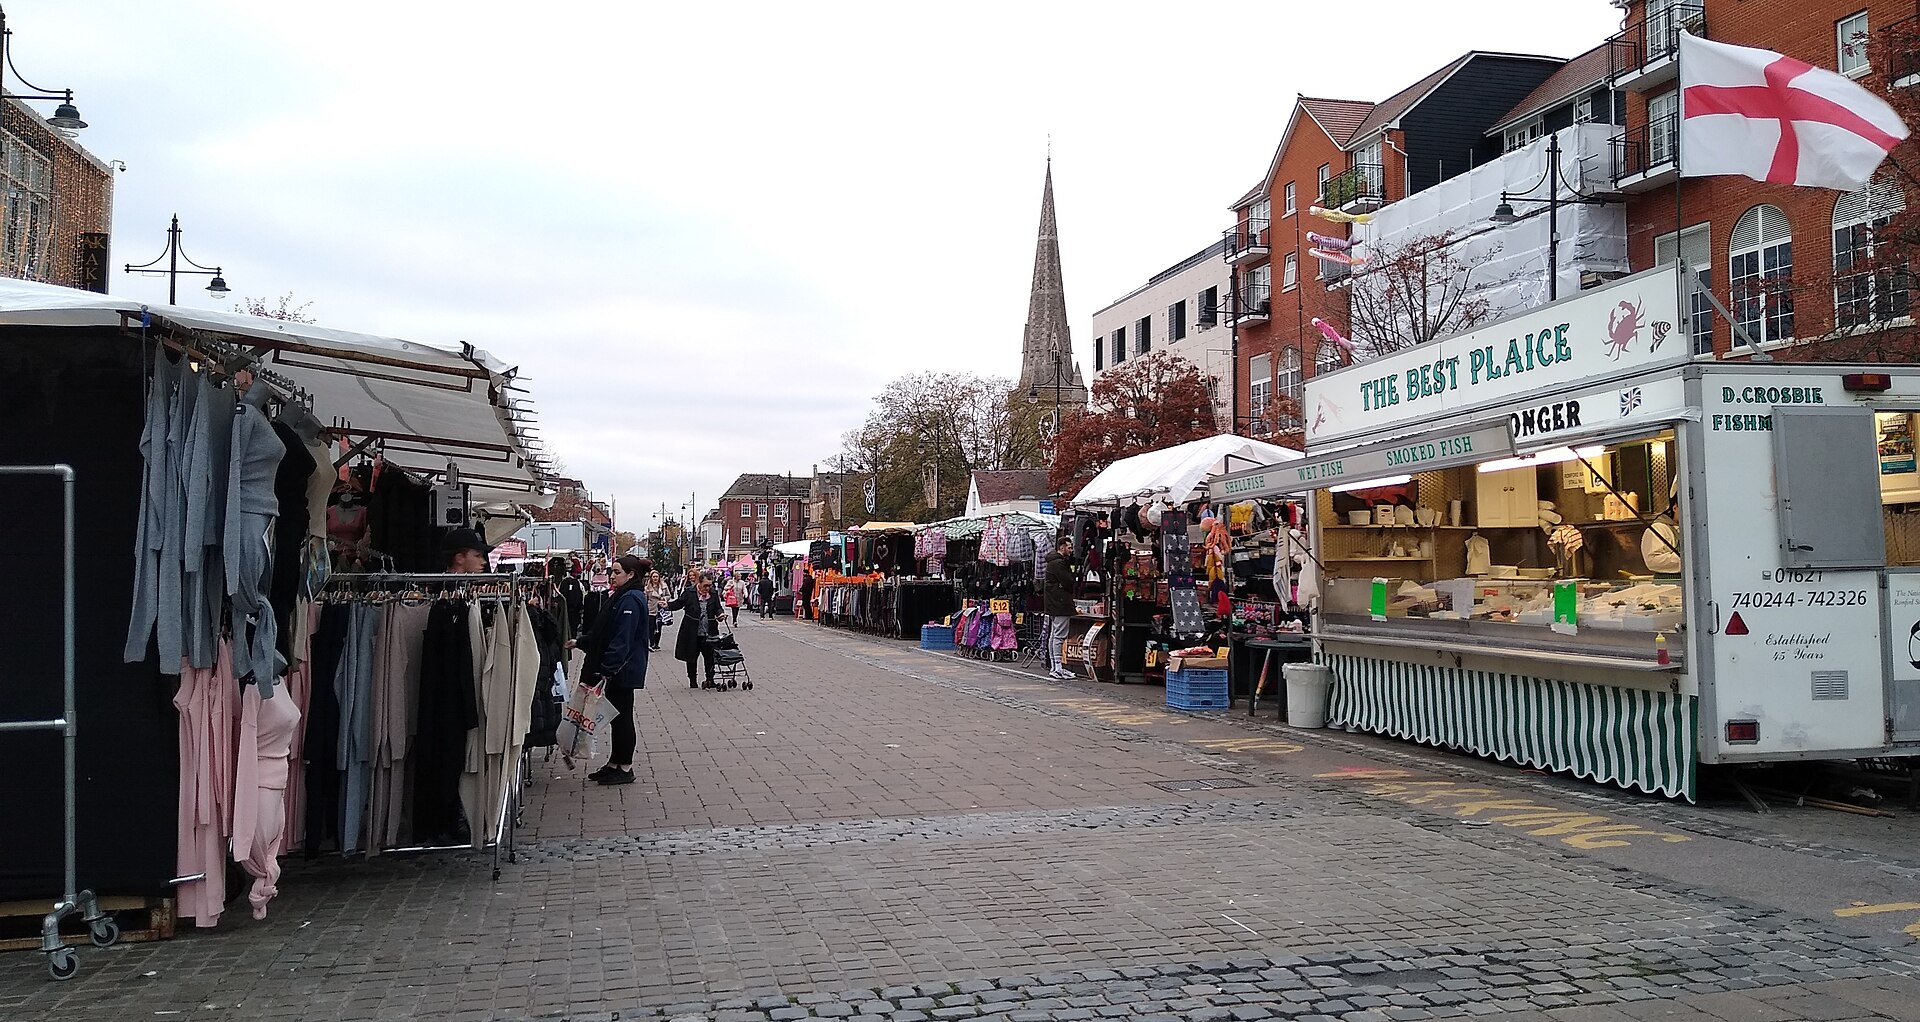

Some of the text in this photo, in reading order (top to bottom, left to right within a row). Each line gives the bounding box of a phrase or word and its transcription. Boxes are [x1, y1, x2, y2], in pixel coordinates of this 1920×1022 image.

[1360, 322, 1573, 411] THE BEST PLAICE
[1722, 386, 1824, 403] D.CROSBIE
[1712, 414, 1773, 431] FISHM
[1386, 436, 1474, 467] SMOKED FISH
[1297, 460, 1344, 482] WET FISH
[1224, 475, 1265, 495] SHELLFISH
[1775, 567, 1823, 583] 01621
[993, 601, 1008, 611] £12
[1765, 633, 1831, 646] Established
[1067, 645, 1097, 660] SAUSES
[1773, 648, 1824, 661] 45 Years
[566, 706, 597, 731] TESCO
